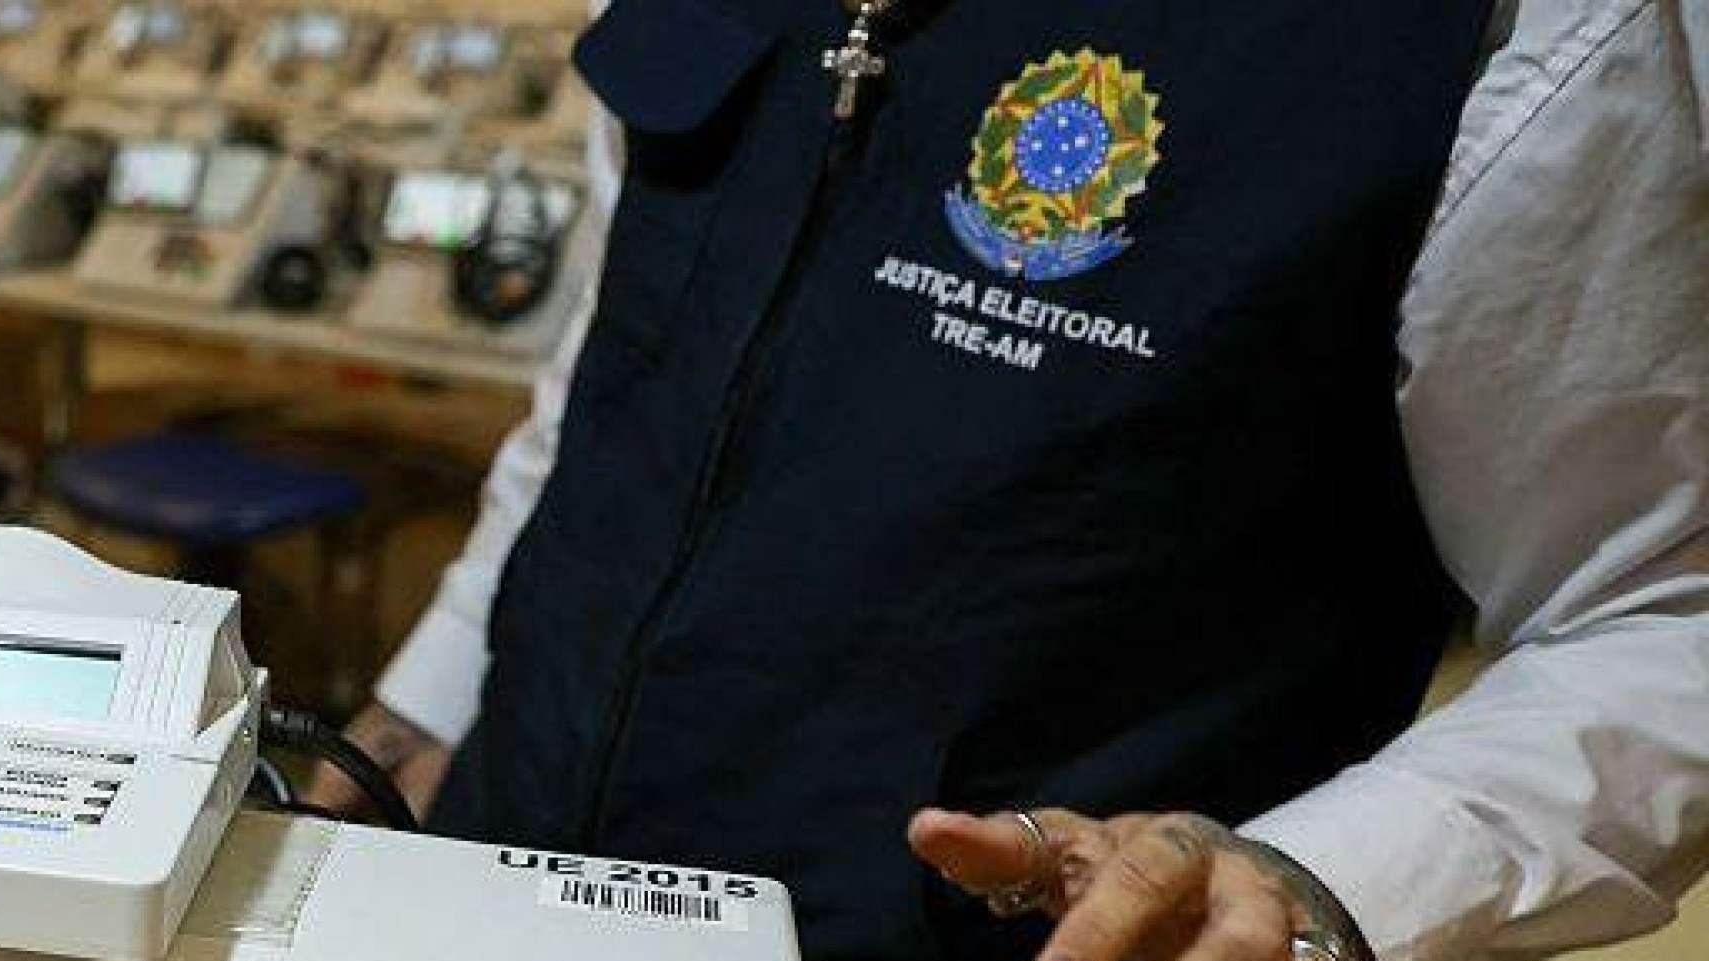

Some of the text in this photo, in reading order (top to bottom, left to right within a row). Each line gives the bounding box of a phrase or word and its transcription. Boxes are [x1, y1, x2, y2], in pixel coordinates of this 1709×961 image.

[931, 312, 1043, 370] TRE-AM
[980, 287, 1155, 357] ELEITORAL
[498, 850, 759, 898] UE 2015
